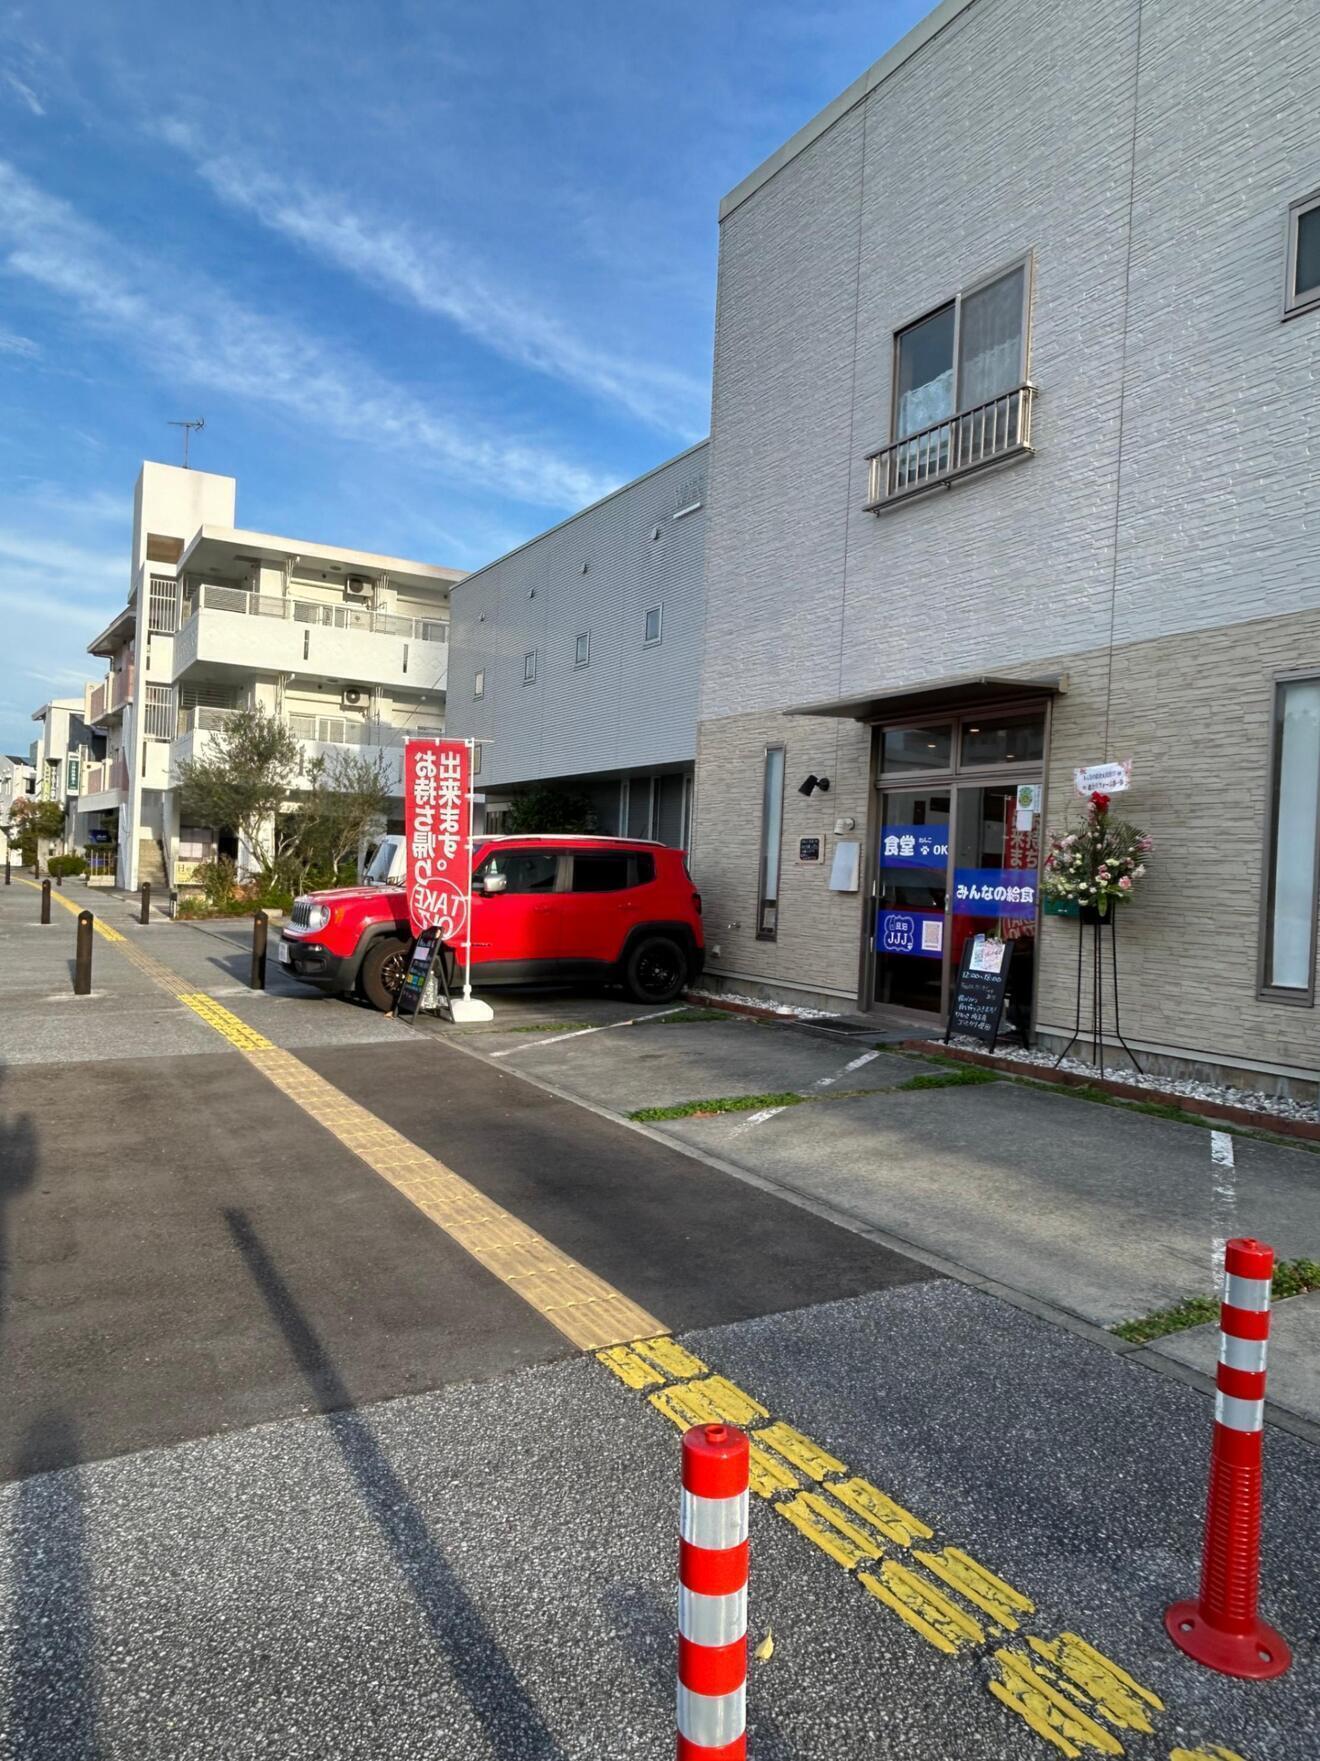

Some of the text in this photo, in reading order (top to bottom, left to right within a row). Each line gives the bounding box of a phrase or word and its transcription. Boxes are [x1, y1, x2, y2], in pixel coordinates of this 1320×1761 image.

[884, 834, 915, 856] 食堂
[933, 844, 949, 856] OK
[956, 884, 1035, 903] みんなの給食
[887, 931, 908, 945] JJJ
